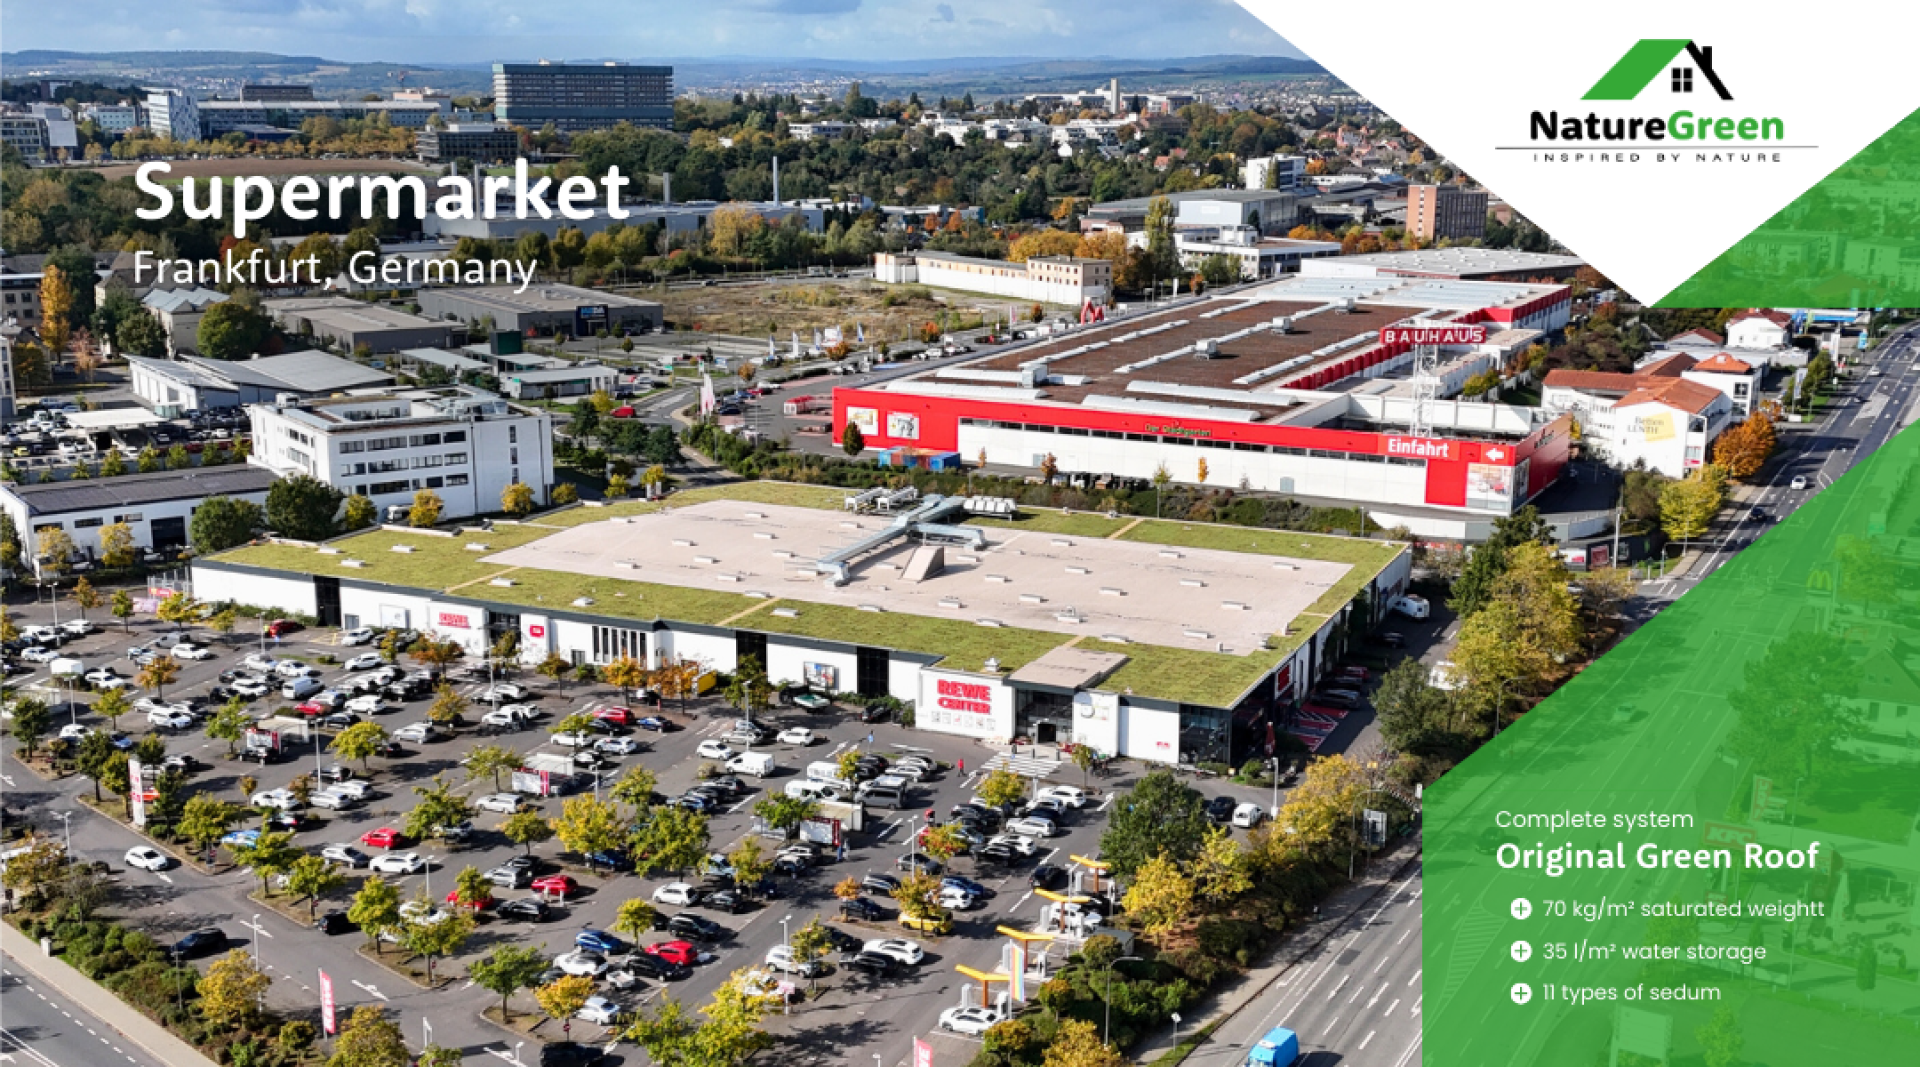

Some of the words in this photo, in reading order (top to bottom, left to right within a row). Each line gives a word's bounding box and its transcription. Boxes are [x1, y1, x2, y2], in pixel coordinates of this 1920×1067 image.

[1384, 329, 1484, 344] BAUHAUS
[1387, 438, 1450, 457] Einfahrt
[937, 679, 992, 702] REWE
[937, 697, 992, 715] CENTER
[1706, 826, 1753, 846] KFC
